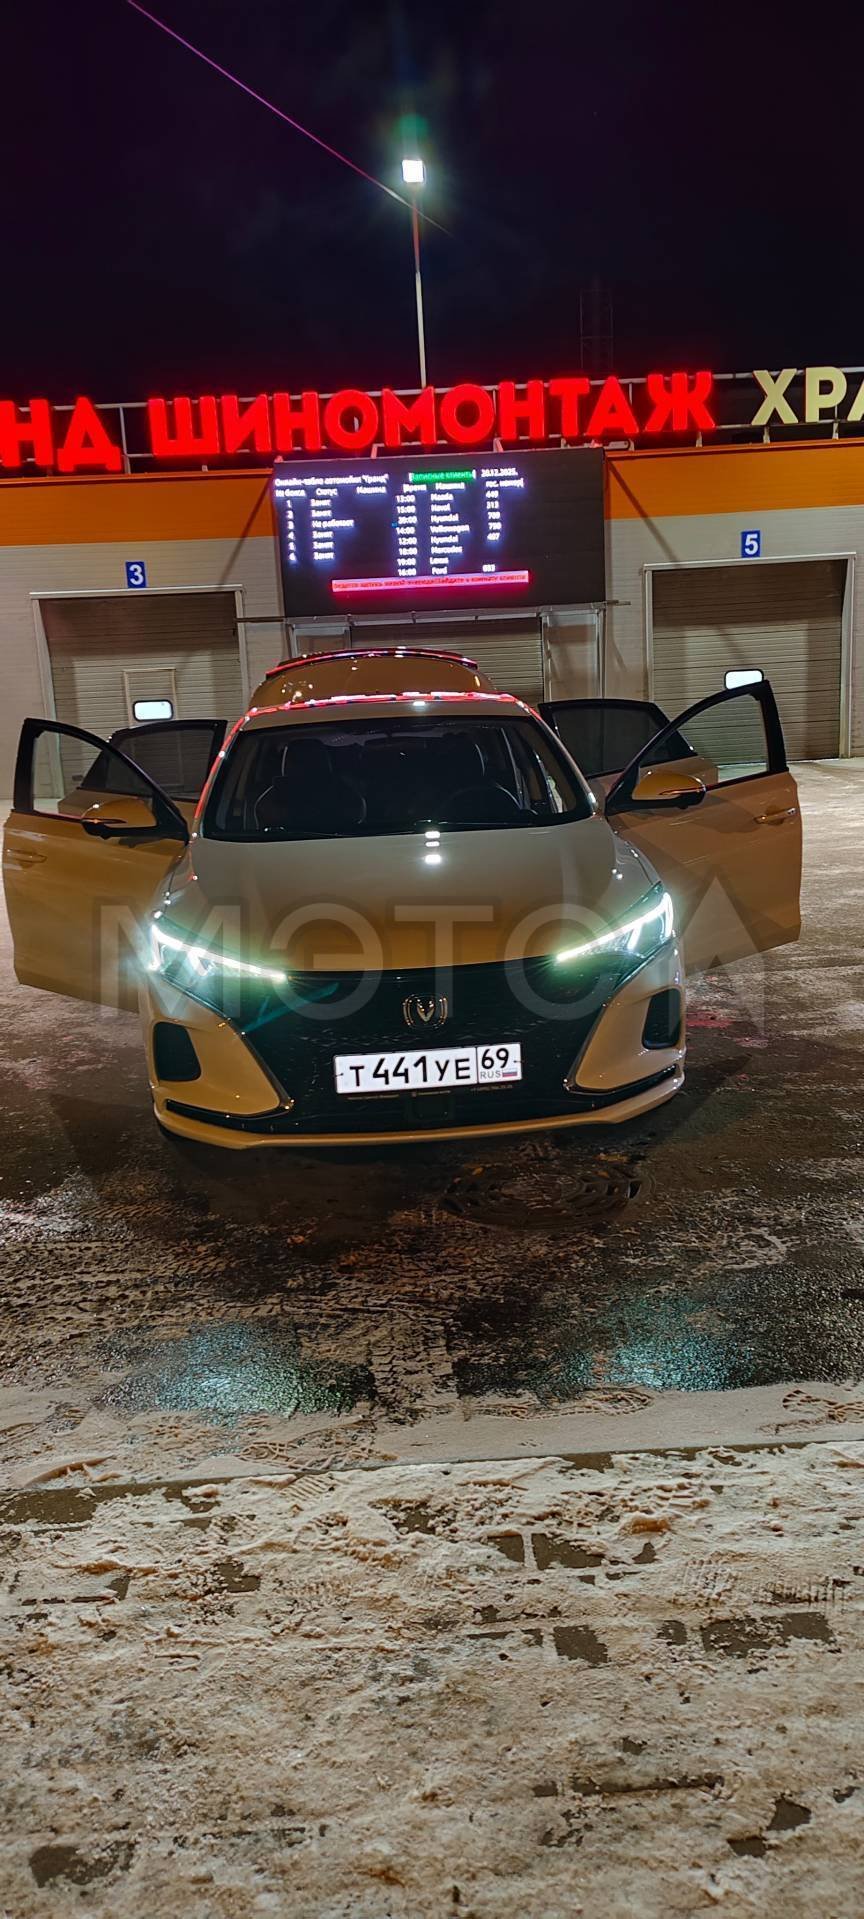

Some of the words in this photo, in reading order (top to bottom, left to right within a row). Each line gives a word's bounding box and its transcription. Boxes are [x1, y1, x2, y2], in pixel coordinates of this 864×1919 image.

[148, 371, 716, 456] ШИНОМОНТАЖ
[0, 397, 121, 472] НД
[745, 533, 759, 555] 5
[129, 564, 144, 585] 3
[481, 1048, 509, 1070] 69
[480, 1070, 501, 1079] RUS
